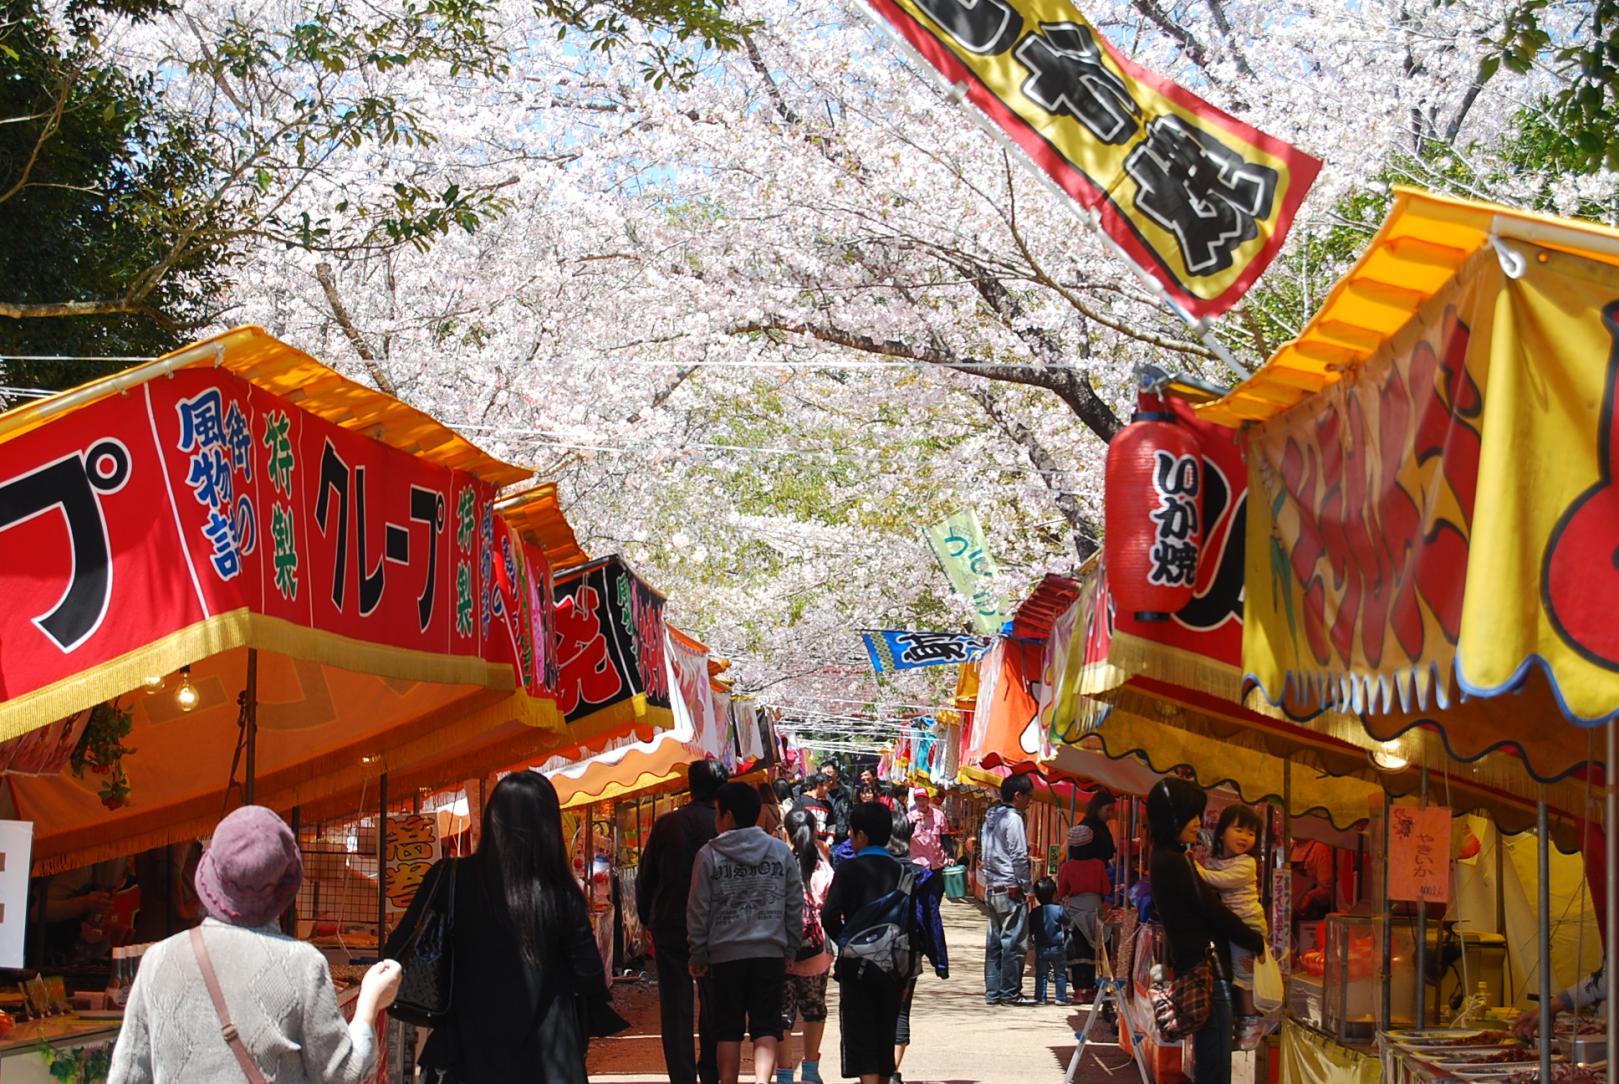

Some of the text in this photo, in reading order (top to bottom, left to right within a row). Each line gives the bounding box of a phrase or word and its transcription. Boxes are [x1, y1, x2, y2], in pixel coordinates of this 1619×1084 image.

[175, 386, 243, 582] 風物詩
[262, 409, 298, 602] 特製
[314, 435, 446, 634] クレープ
[456, 484, 476, 640] 特製
[1148, 449, 1200, 587] いか焼
